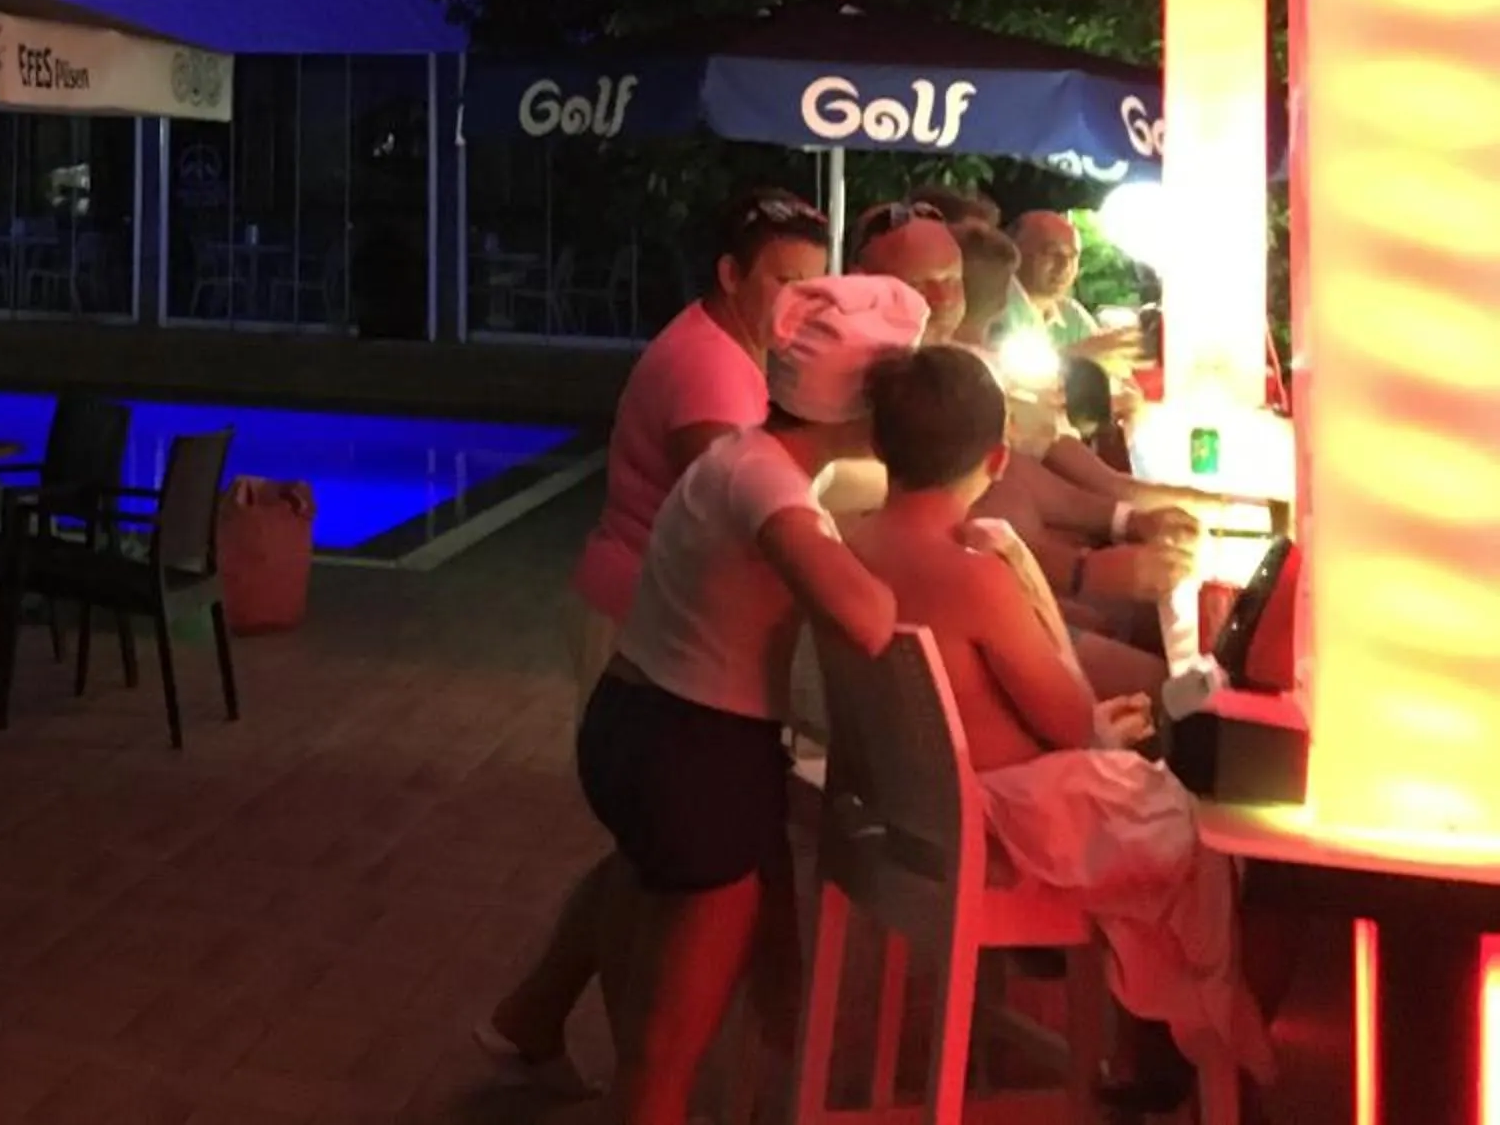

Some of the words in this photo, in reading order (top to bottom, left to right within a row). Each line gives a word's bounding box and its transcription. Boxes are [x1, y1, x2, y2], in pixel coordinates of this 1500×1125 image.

[17, 43, 52, 89] EFES
[54, 58, 90, 90] Pilsen
[517, 74, 639, 139] Golf
[800, 75, 978, 148] Golf
